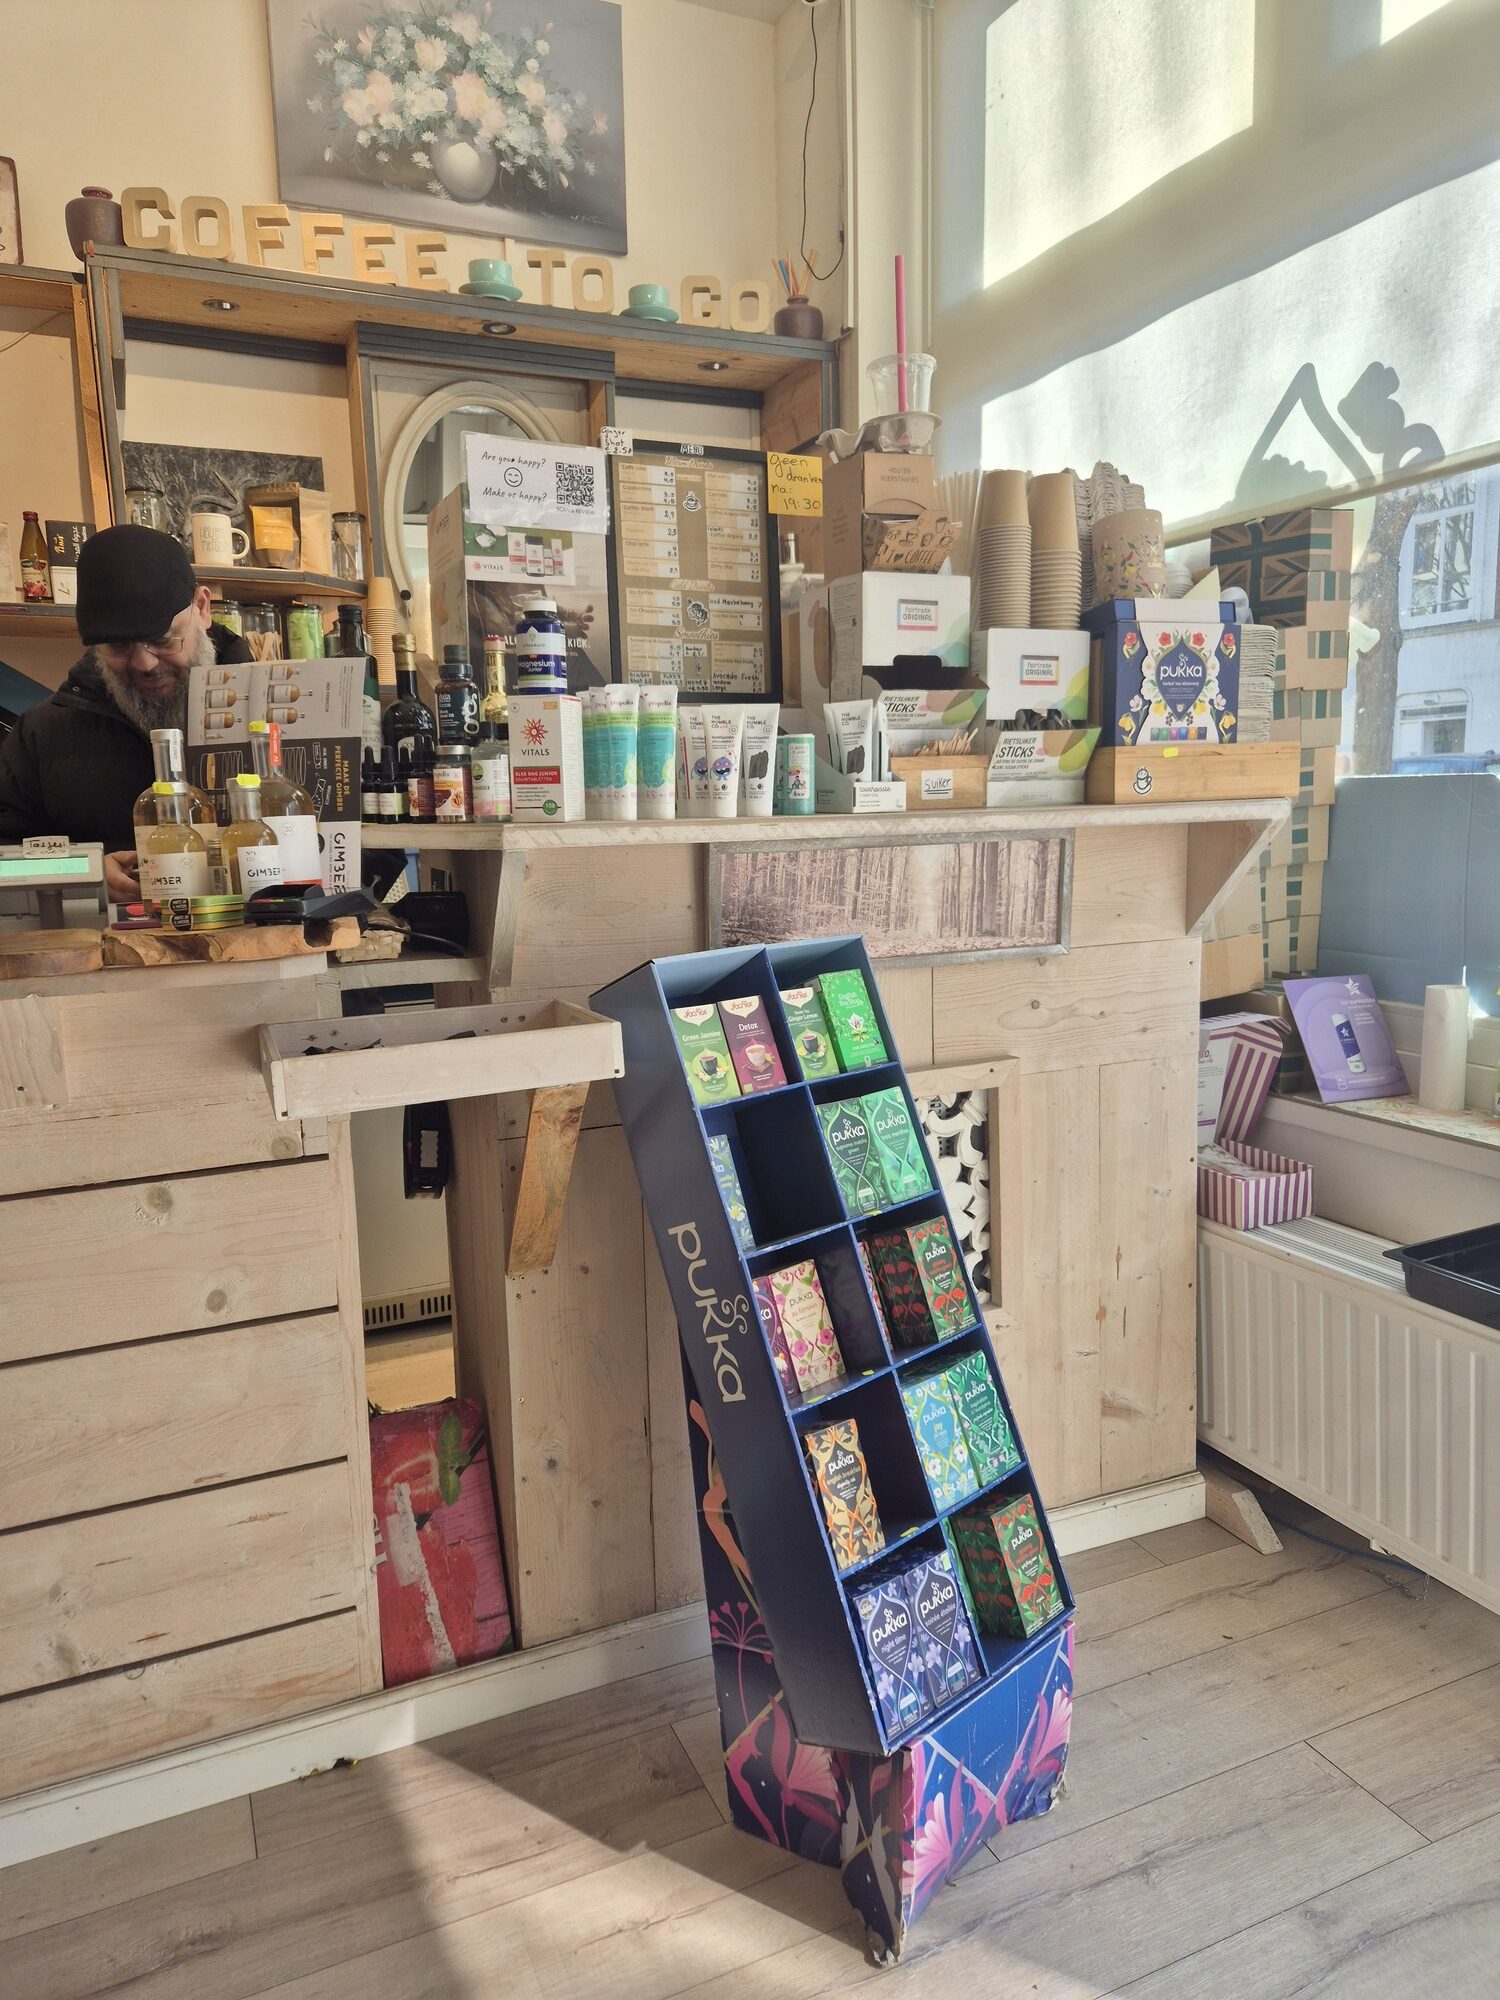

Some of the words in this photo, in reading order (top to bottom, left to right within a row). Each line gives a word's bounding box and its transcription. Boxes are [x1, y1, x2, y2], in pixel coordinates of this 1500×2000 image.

[121, 186, 451, 293] COFFEE
[526, 250, 615, 314] TO
[680, 275, 779, 334] GO
[481, 451, 496, 461] Are
[517, 456, 547, 469] happy?
[769, 454, 808, 478] geen
[483, 487, 505, 498] Make
[519, 492, 547, 504] happy?
[783, 498, 821, 511] 19:30
[902, 613, 933, 622] ORIGINAL
[905, 606, 931, 614] fairtrade
[1025, 668, 1054, 676] ORIGINAL
[1027, 661, 1052, 669] fairtrade
[1160, 664, 1203, 680] pukka
[738, 1023, 758, 1031] Detox
[876, 1114, 906, 1133] pukka
[832, 1125, 865, 1145] pukka
[925, 1245, 947, 1262] pukka
[668, 1222, 748, 1404] pukka
[965, 1383, 987, 1402] pukka
[922, 1406, 947, 1426] pukka
[828, 1454, 855, 1475] pukka
[1011, 1528, 1034, 1550] pukka
[919, 1587, 954, 1618] pukka
[872, 1612, 908, 1647] pukka
